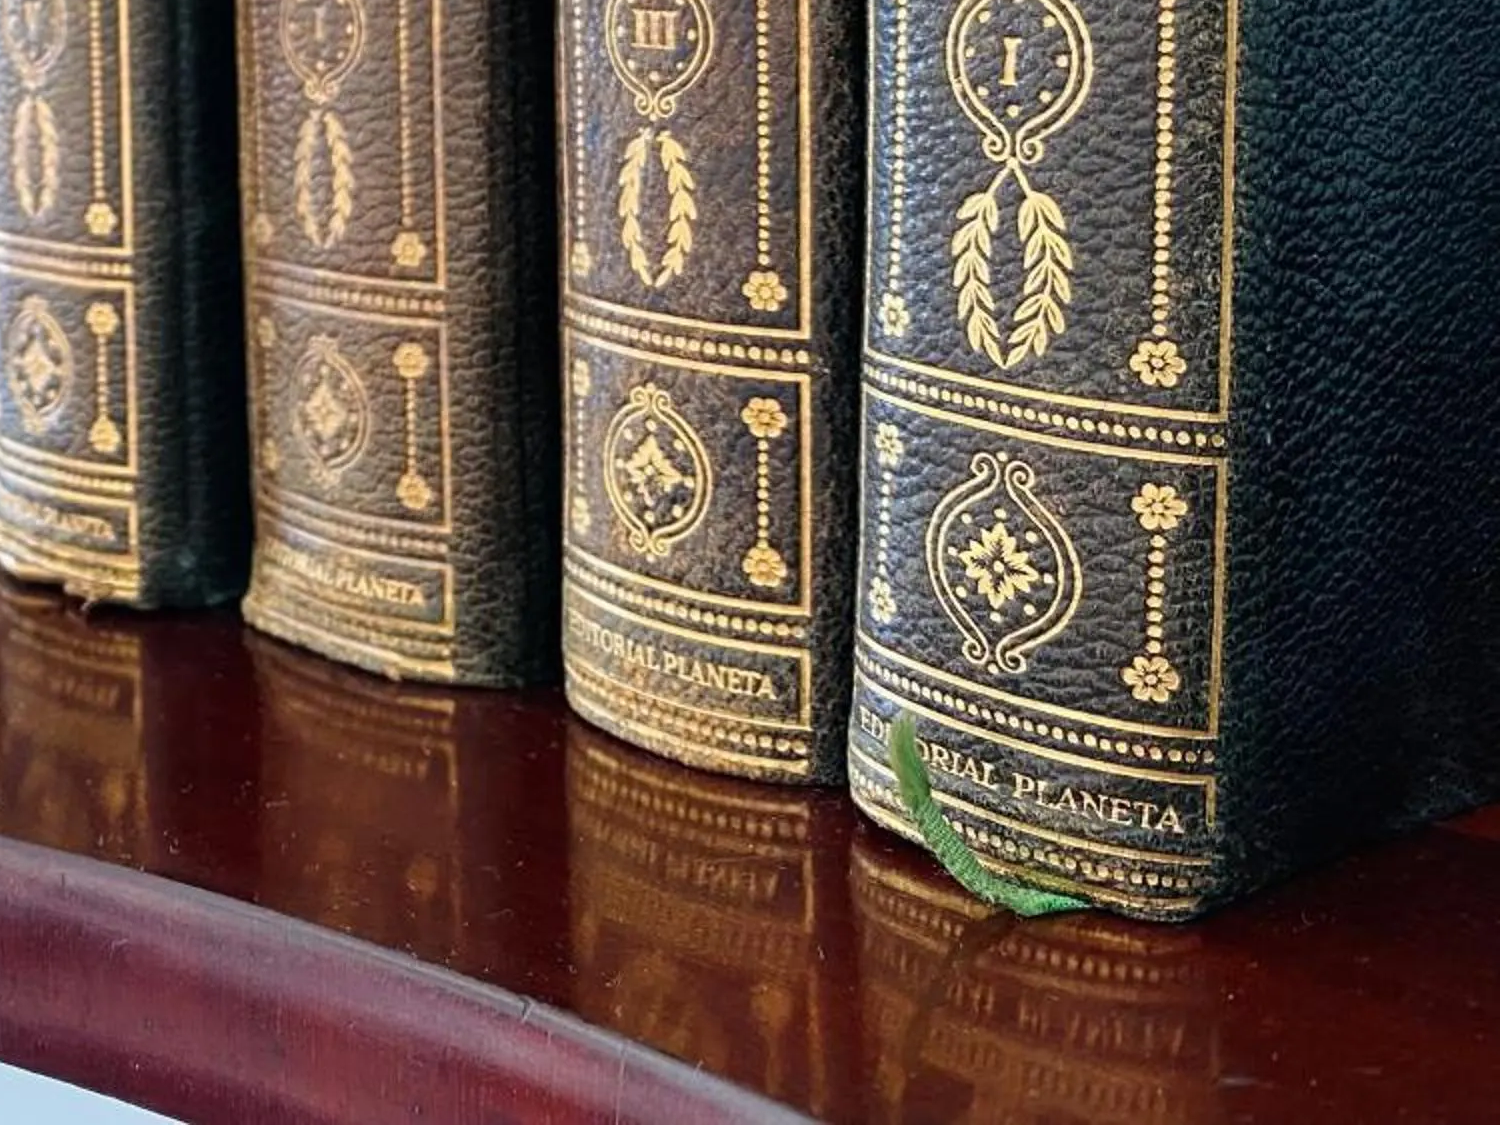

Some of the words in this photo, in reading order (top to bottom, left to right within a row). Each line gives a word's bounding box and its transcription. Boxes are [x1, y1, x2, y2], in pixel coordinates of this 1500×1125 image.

[631, 8, 678, 50] III
[1000, 36, 1023, 86] I
[662, 651, 778, 701] PLANETA
[859, 704, 999, 789] EDIORIAL
[1011, 771, 1184, 834] PLANETA
